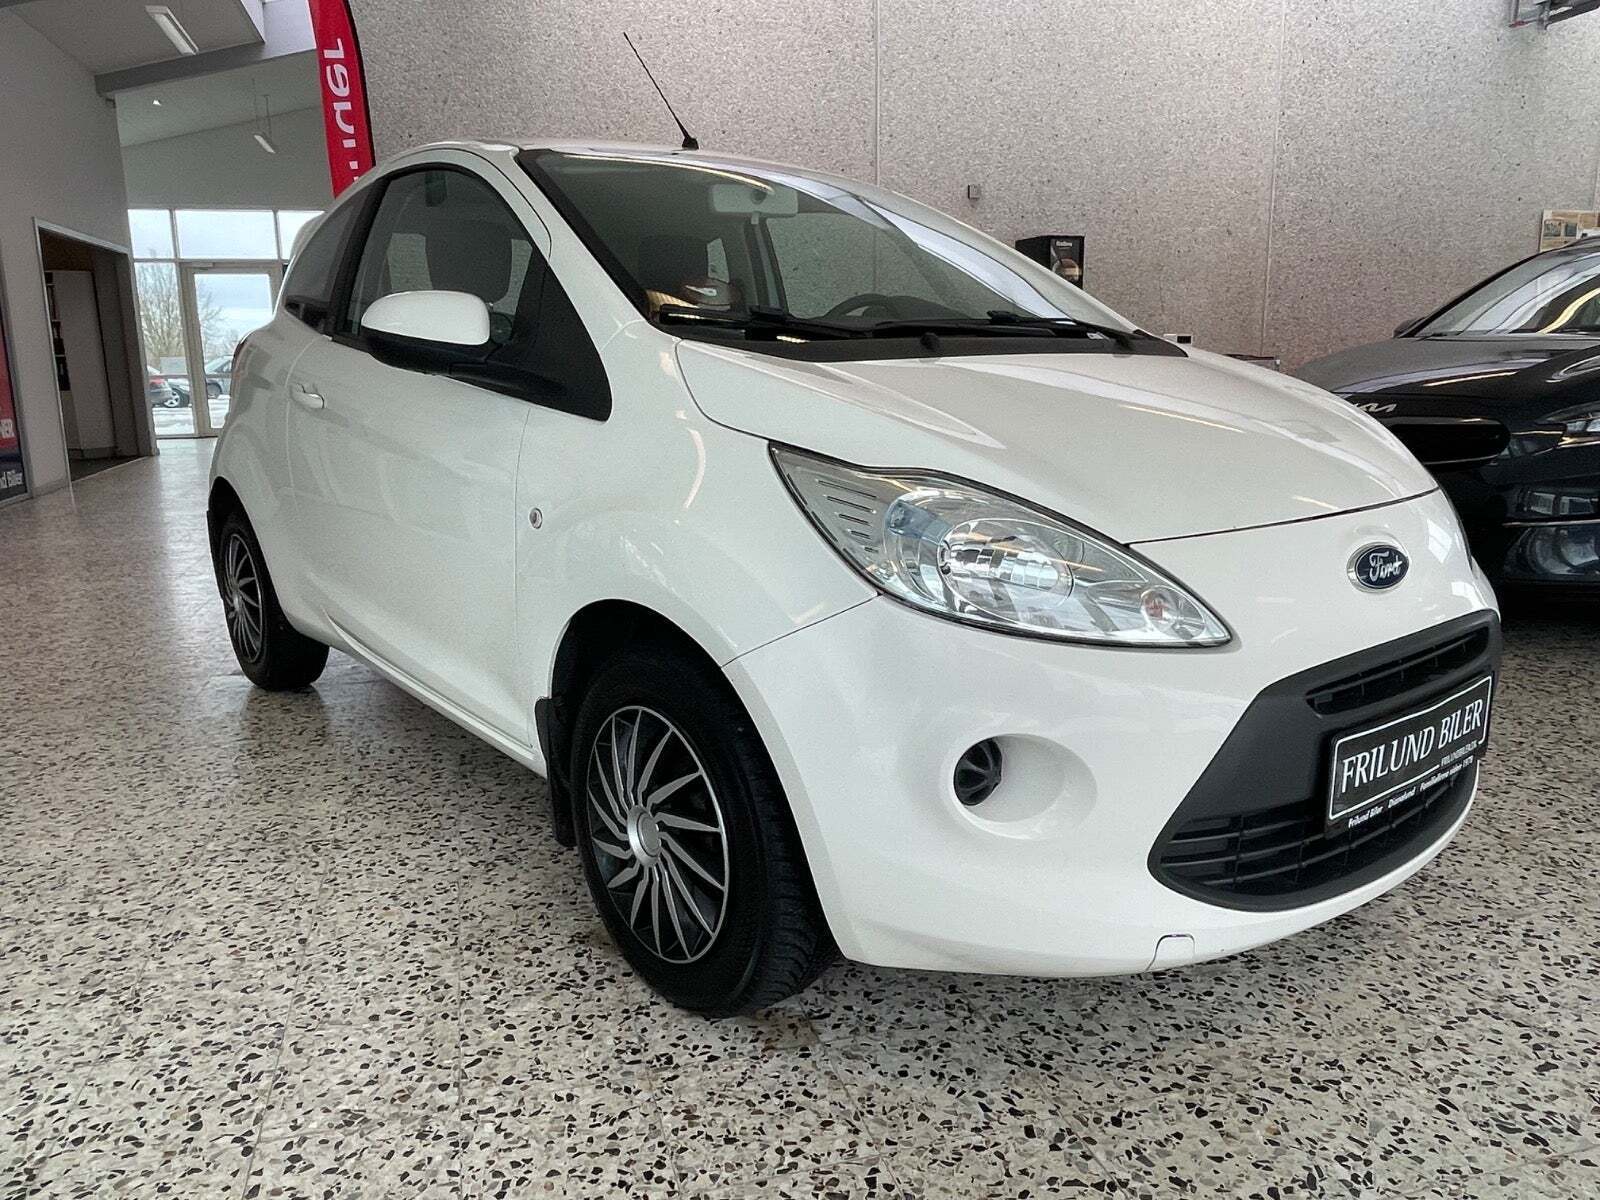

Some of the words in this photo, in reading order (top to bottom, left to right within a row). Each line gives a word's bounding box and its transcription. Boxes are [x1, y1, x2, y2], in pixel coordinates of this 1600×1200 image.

[1369, 551, 1403, 582] Ford
[1341, 726, 1435, 793] FRILUND
[1438, 699, 1483, 749] BILER
